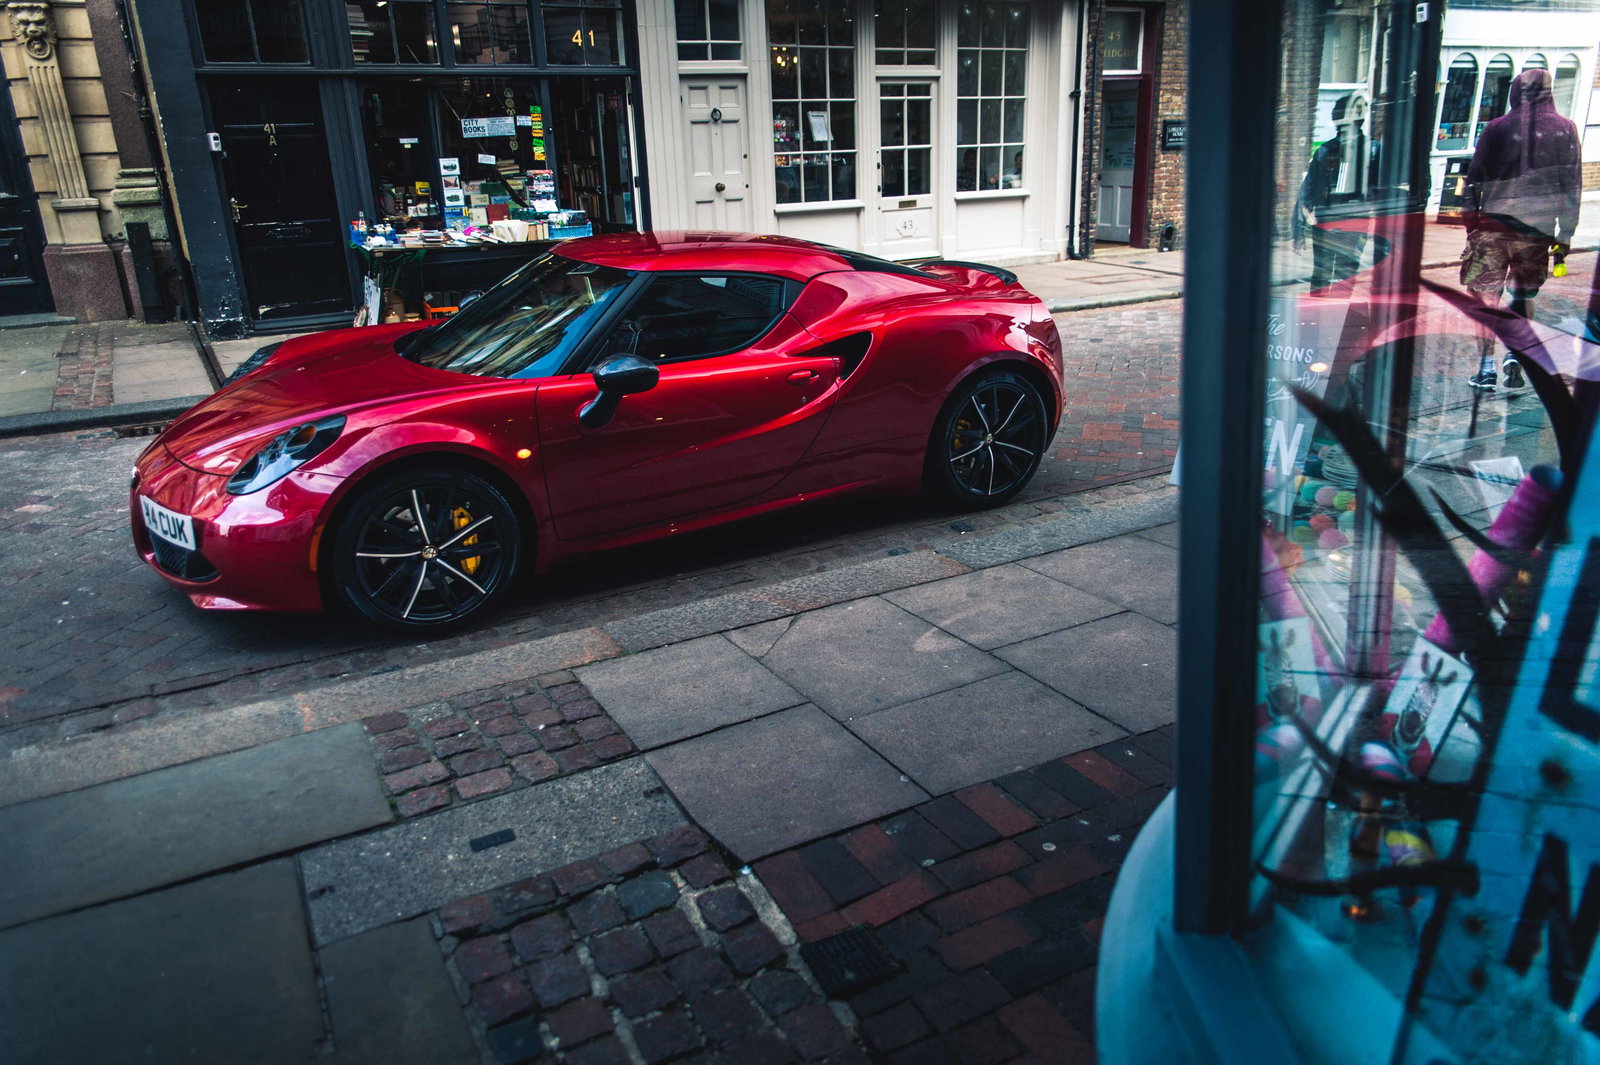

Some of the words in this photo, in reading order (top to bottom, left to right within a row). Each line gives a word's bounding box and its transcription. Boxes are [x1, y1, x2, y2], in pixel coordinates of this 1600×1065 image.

[572, 30, 595, 46] 41
[264, 123, 276, 134] 41
[463, 126, 486, 134] BOOKS
[270, 135, 277, 146] A
[902, 220, 913, 230] 43
[1267, 345, 1314, 364] RSONS
[1264, 418, 1305, 477] N
[158, 511, 189, 543] CUK
